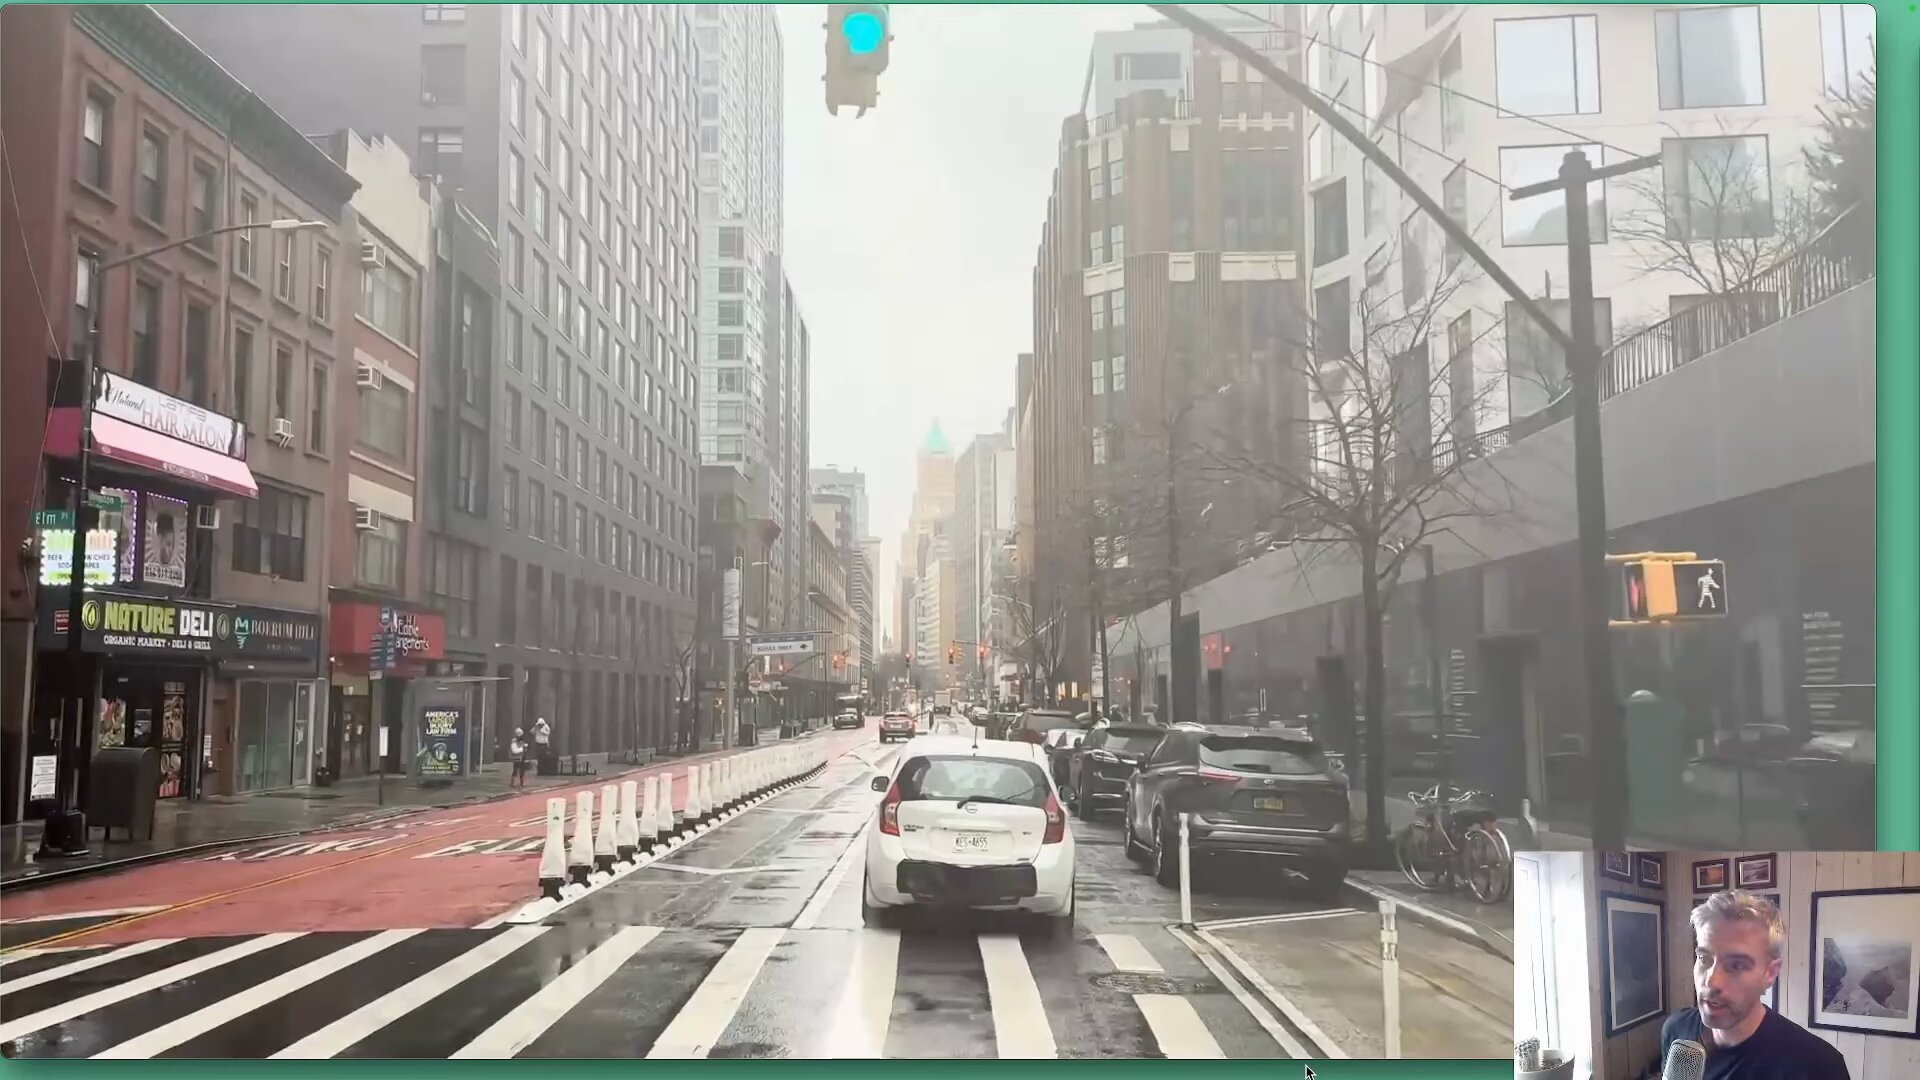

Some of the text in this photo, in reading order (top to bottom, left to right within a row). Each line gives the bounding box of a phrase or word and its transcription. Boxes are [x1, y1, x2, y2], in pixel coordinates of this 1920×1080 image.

[110, 386, 144, 411] Natural
[140, 402, 227, 450] HAIR SALON
[35, 511, 56, 525] Elm
[104, 601, 176, 636] NATURE
[179, 611, 214, 638] DELI
[103, 635, 136, 647] ORGANIC
[137, 637, 166, 649] MARKET
[171, 639, 186, 649] DELI
[193, 640, 211, 651] GRILL
